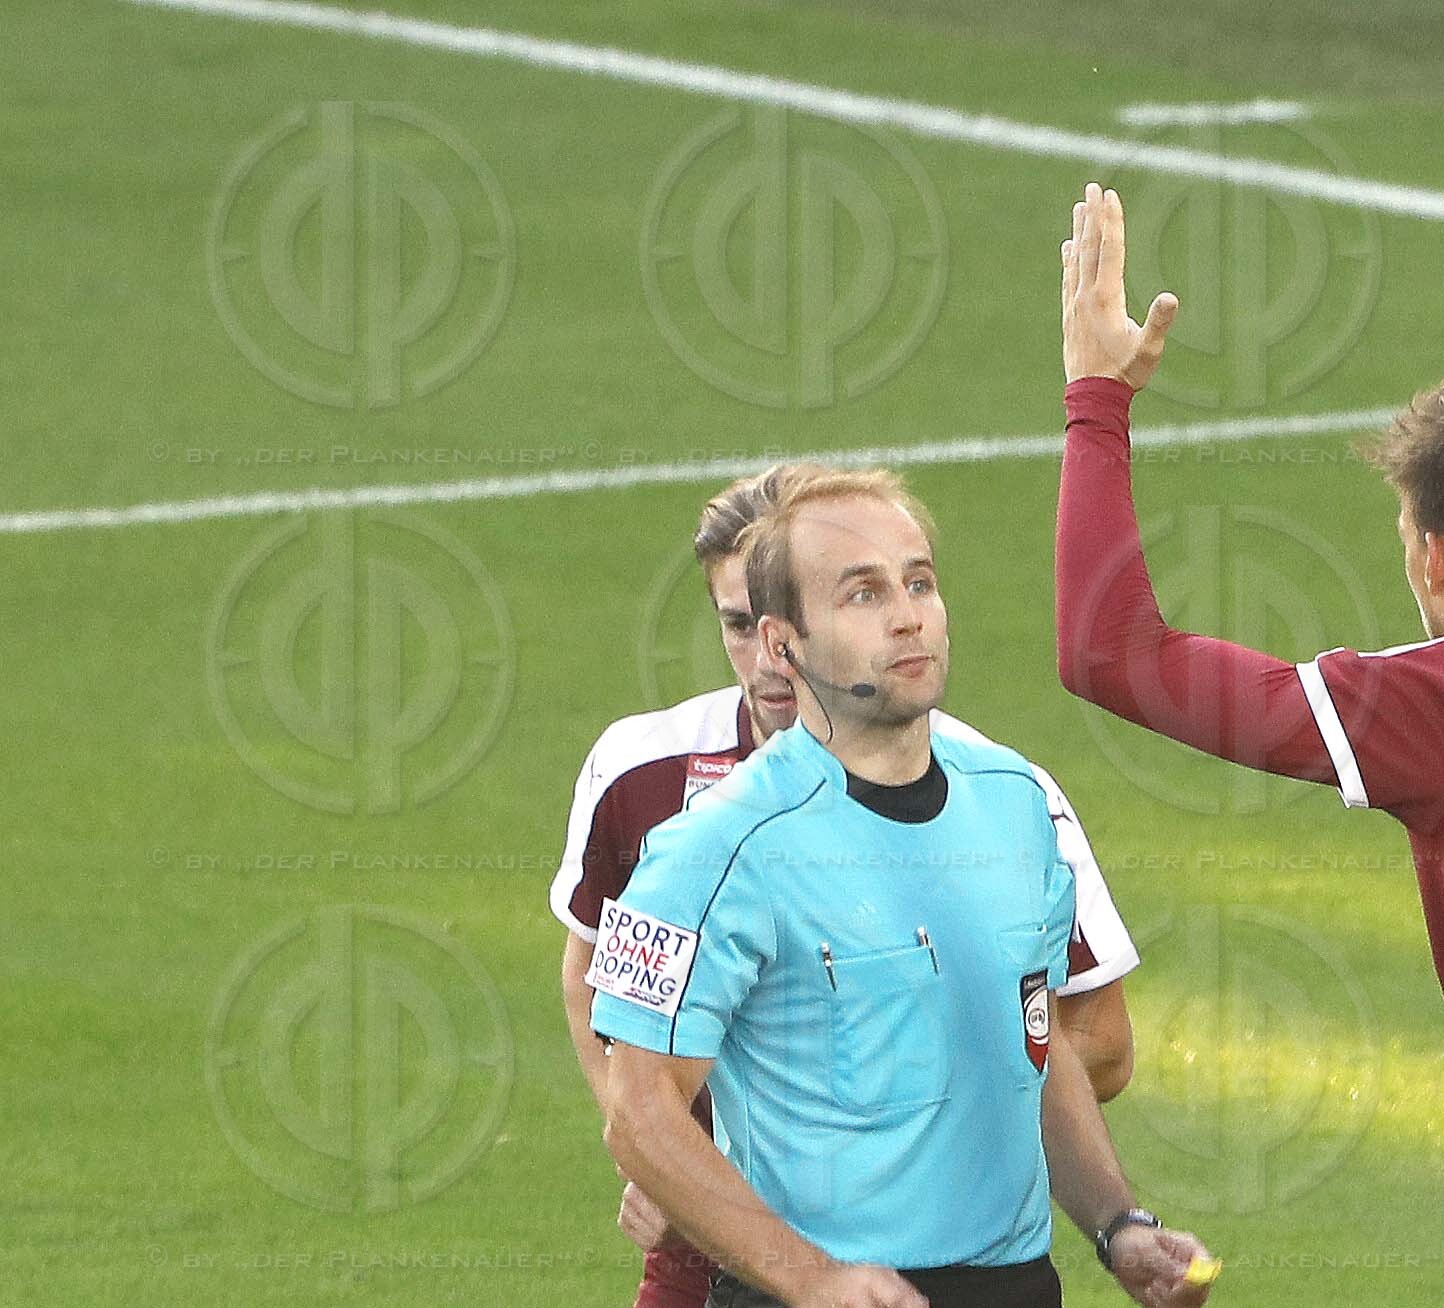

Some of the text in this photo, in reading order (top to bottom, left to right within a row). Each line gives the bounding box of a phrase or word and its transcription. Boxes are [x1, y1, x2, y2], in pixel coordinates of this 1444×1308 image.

[605, 907, 689, 956] SPORT
[607, 935, 670, 972] OHNE
[595, 950, 677, 996] DOPING
